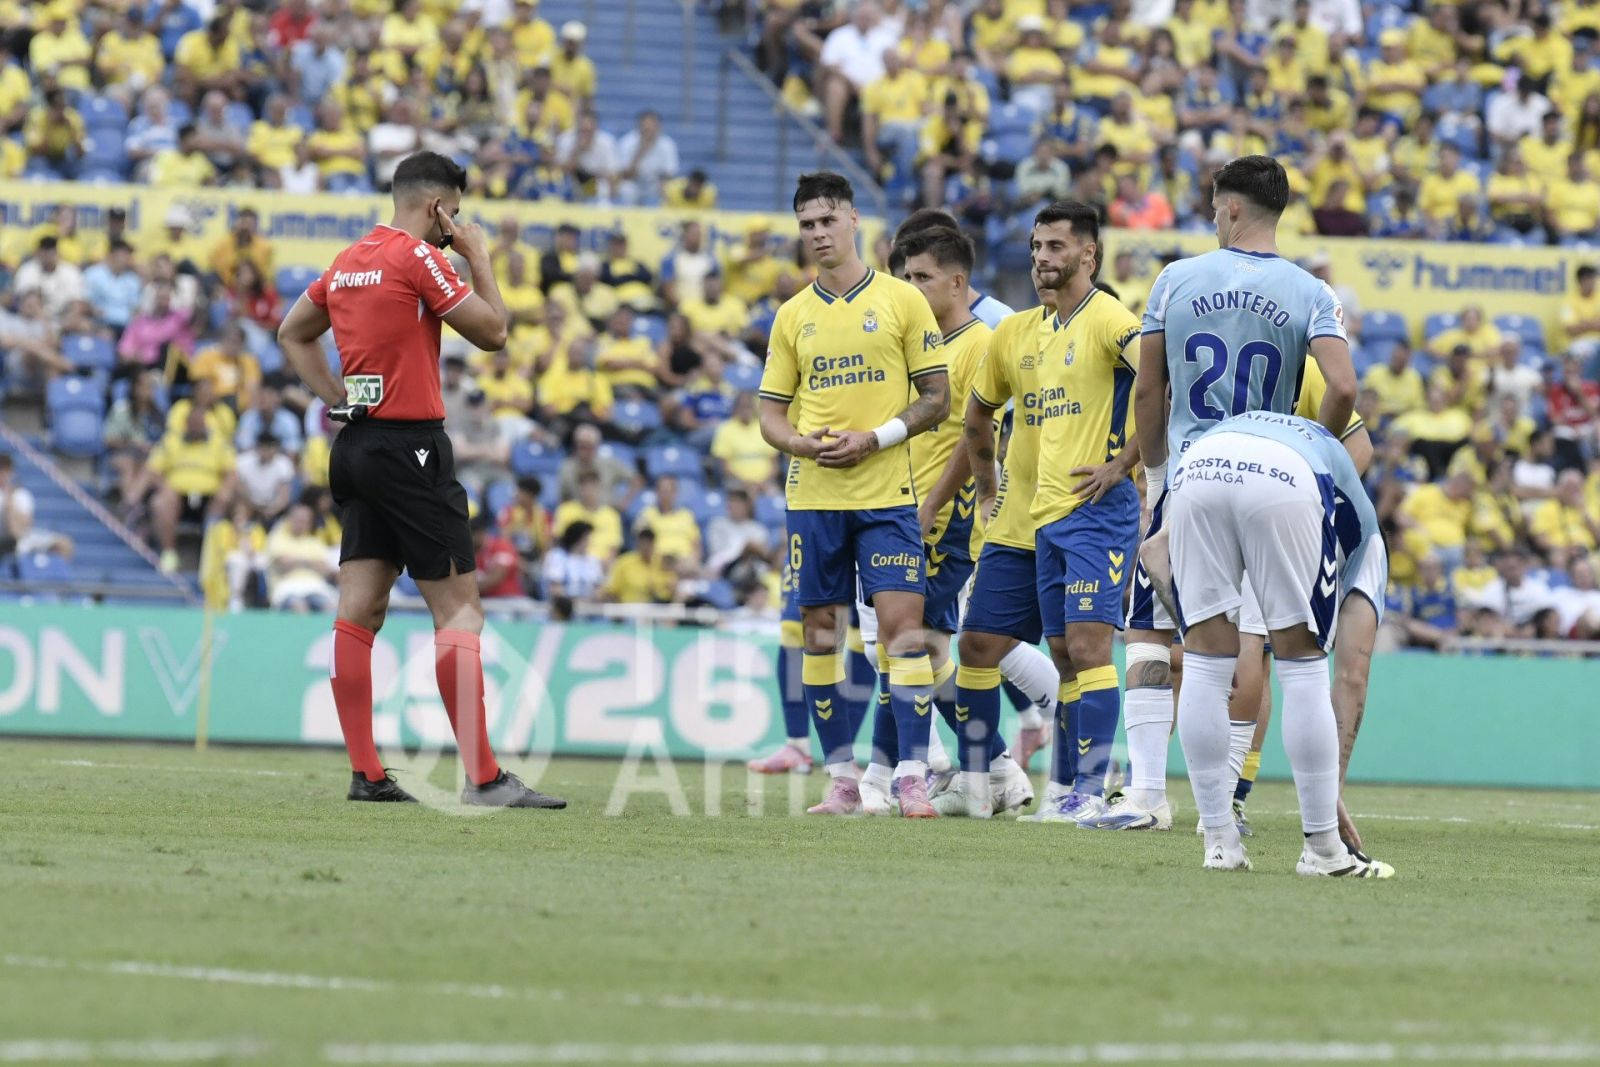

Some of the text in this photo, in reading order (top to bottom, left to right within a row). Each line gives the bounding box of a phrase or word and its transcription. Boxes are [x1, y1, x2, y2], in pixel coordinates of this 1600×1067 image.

[1413, 254, 1567, 295] hummel
[1192, 290, 1290, 328] MONTERO
[808, 367, 886, 391] Canaria
[812, 354, 864, 373] Gran
[1184, 332, 1282, 422] 20
[346, 380, 381, 401] BKT
[1188, 457, 1297, 488] COSTA DEL SOL
[790, 533, 803, 570] 6
[871, 552, 920, 568] Cordial
